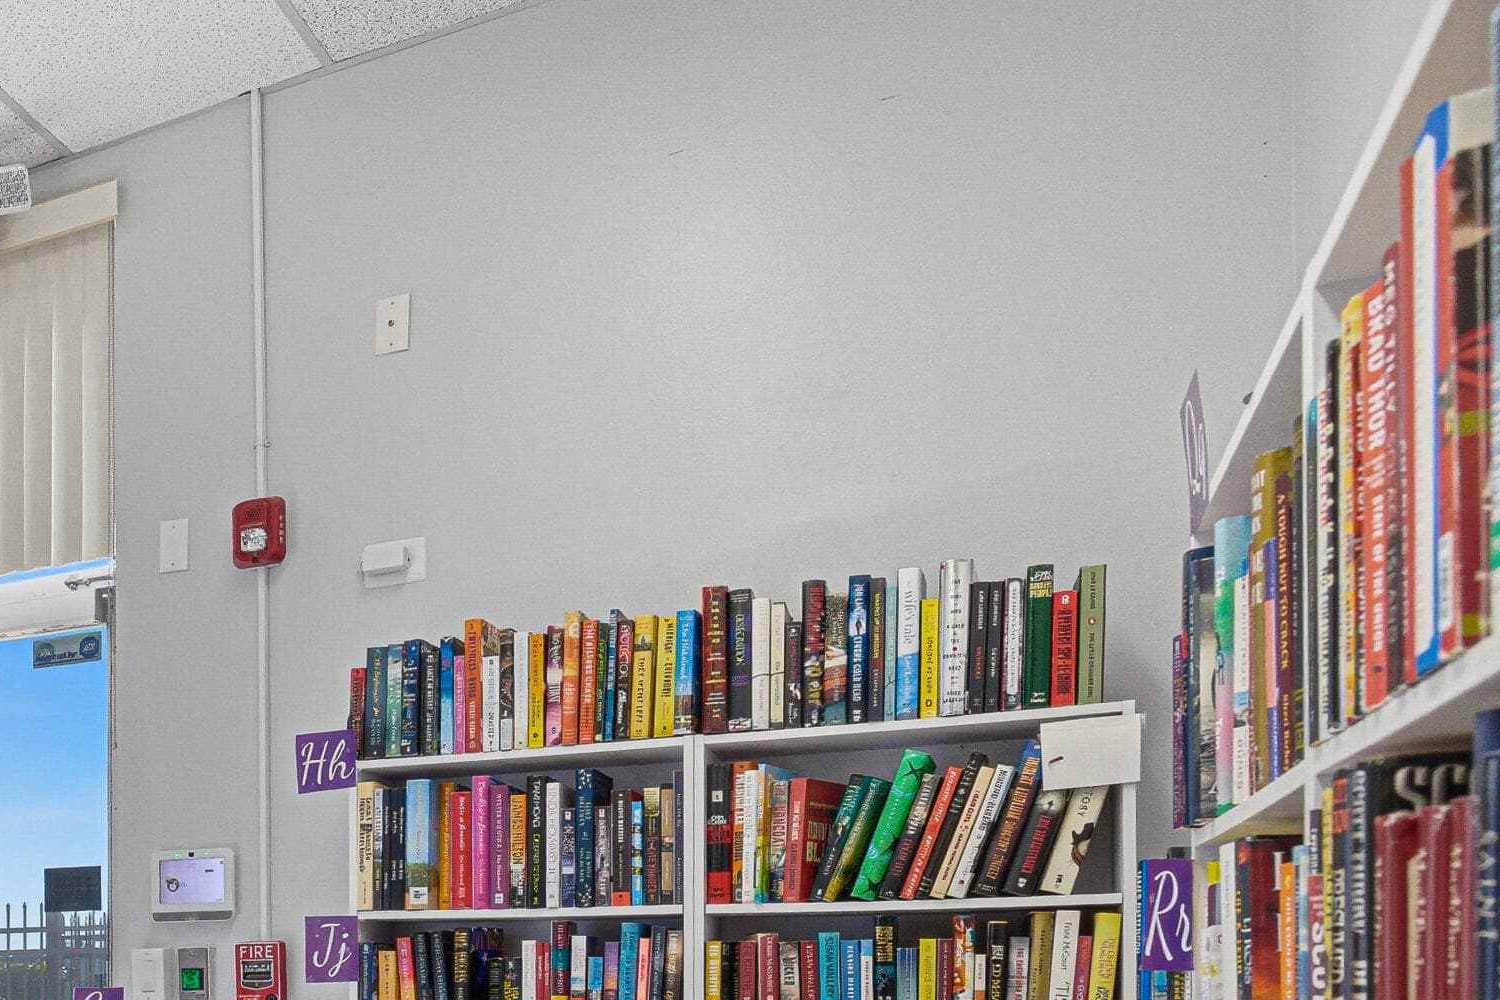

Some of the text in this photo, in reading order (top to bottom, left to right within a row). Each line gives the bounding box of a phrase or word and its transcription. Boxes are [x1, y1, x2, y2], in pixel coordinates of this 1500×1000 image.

[1367, 295, 1386, 372] BRAD
[1367, 378, 1386, 450] THOR
[1371, 493, 1383, 536] STATE
[1277, 494, 1290, 670] A TOUGH NUT TO CRACK
[903, 590, 917, 645] wife's tale
[300, 738, 355, 786] Hh
[512, 800, 526, 865] JAMES HILTON
[1077, 790, 1091, 817] TORY
[1144, 870, 1193, 961] Rr
[1331, 869, 1345, 985] PRESUMED
[239, 944, 274, 959] FIRE
[313, 923, 352, 978] Jj
